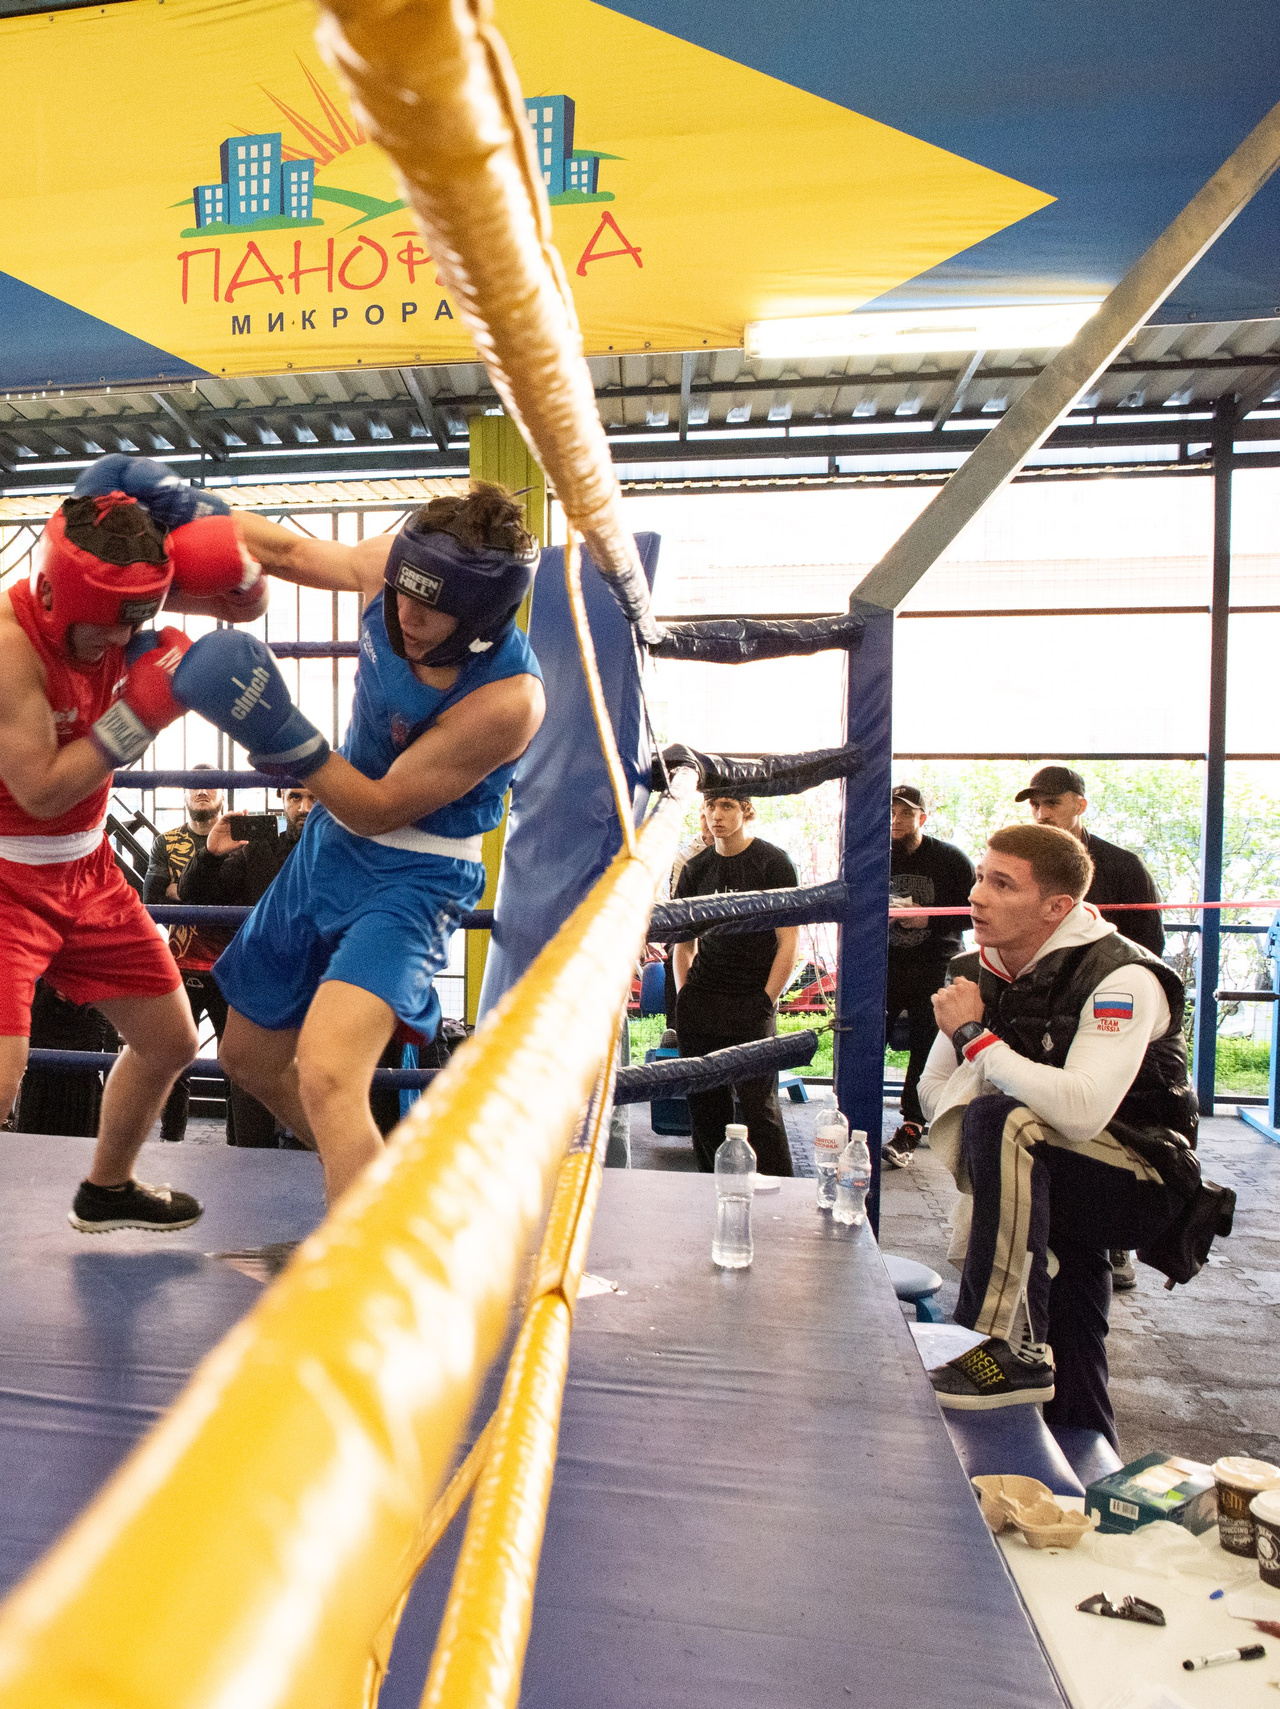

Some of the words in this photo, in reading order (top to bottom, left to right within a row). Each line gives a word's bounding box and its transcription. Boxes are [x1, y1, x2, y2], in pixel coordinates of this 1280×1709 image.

[177, 211, 643, 304] ПАНОРА
[231, 300, 455, 336] МИКРОРА
[399, 575, 430, 597] HILL
[401, 566, 439, 591] GREEN
[231, 666, 271, 721] clinch
[1097, 1024, 1120, 1032] RUSSIA
[1100, 1018, 1119, 1027] TEAM
